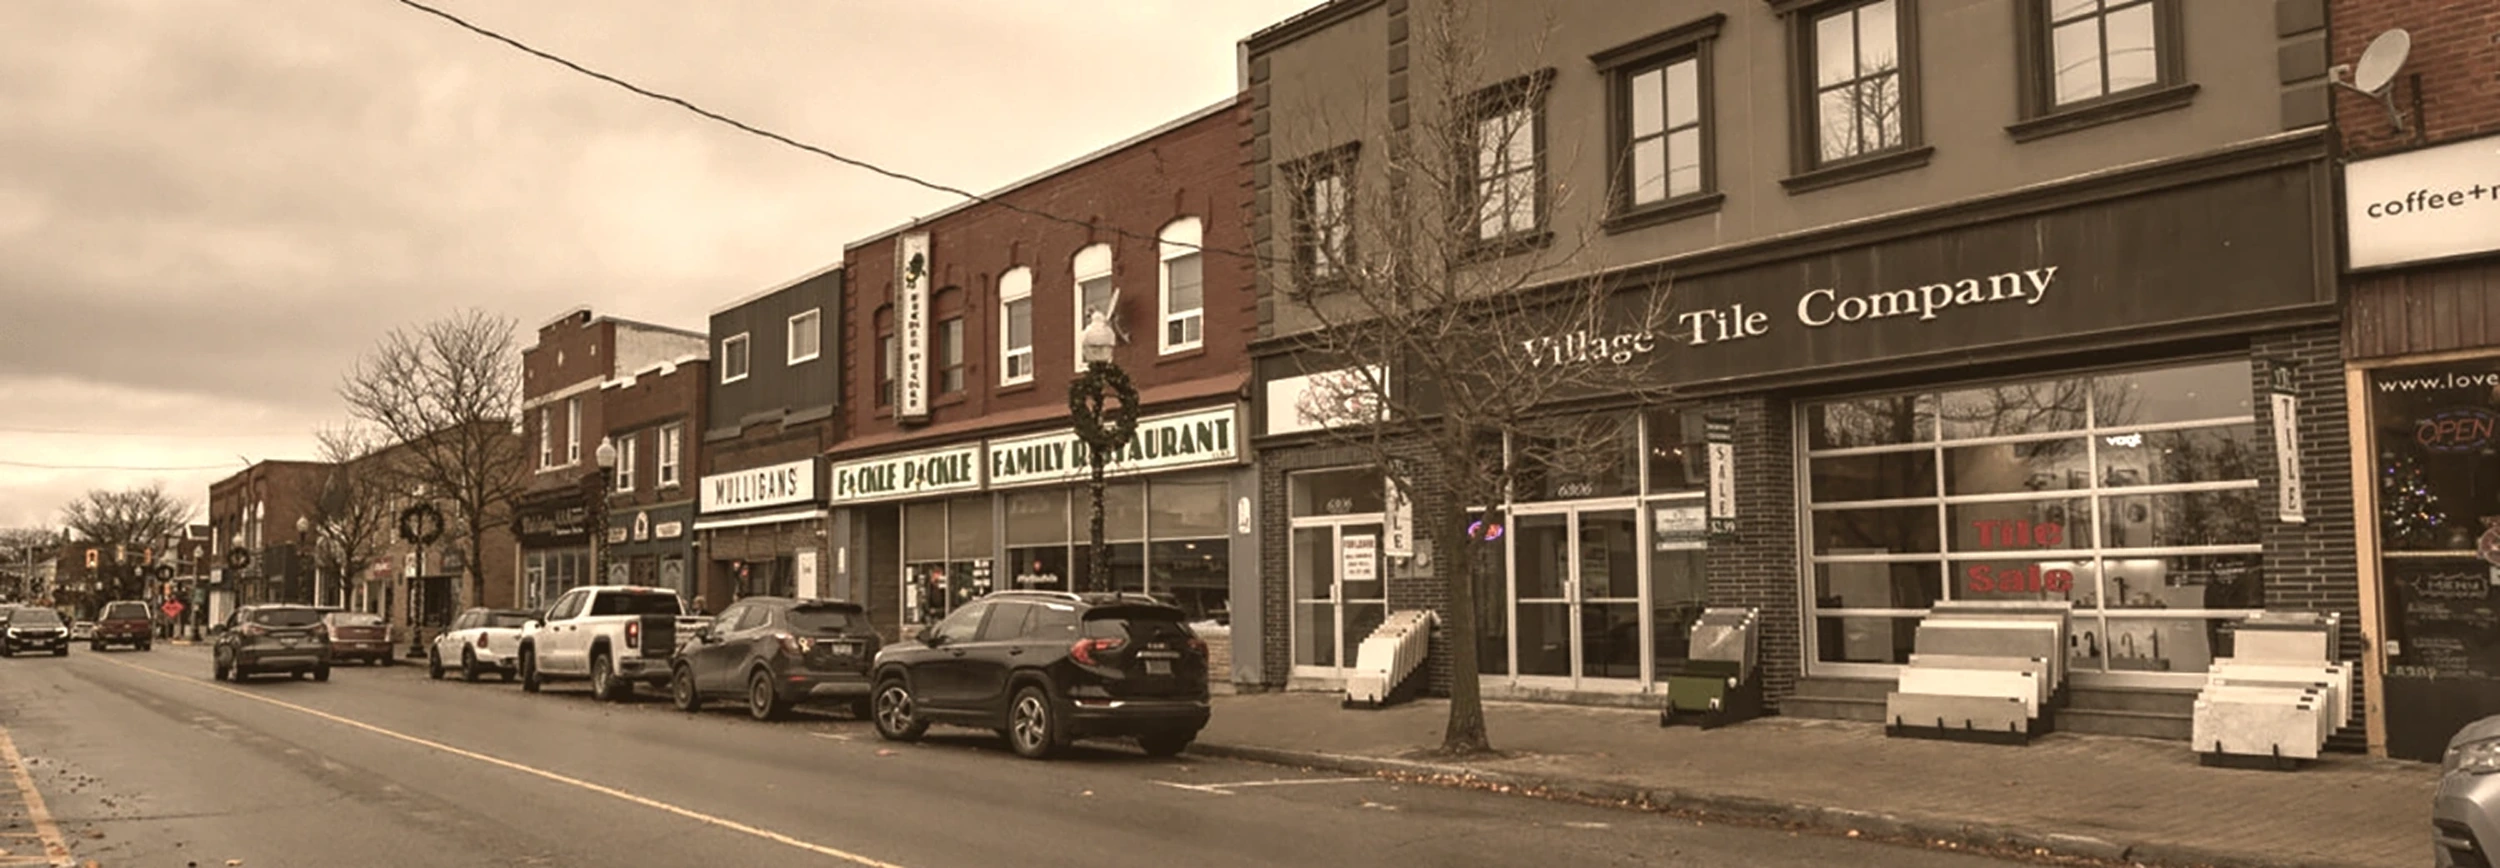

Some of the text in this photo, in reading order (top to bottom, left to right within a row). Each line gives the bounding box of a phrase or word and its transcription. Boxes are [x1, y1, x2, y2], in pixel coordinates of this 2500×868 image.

[1524, 265, 2058, 367] Village Tile Company
[992, 418, 1230, 478] FAMILY RAURANT
[2282, 398, 2297, 510] TILE
[2417, 418, 2494, 445] OPEN
[716, 467, 798, 505] MULLIGANS
[1717, 446, 1726, 516] SALE
[1973, 519, 2064, 548] Tile
[1967, 564, 2075, 593] Sale
